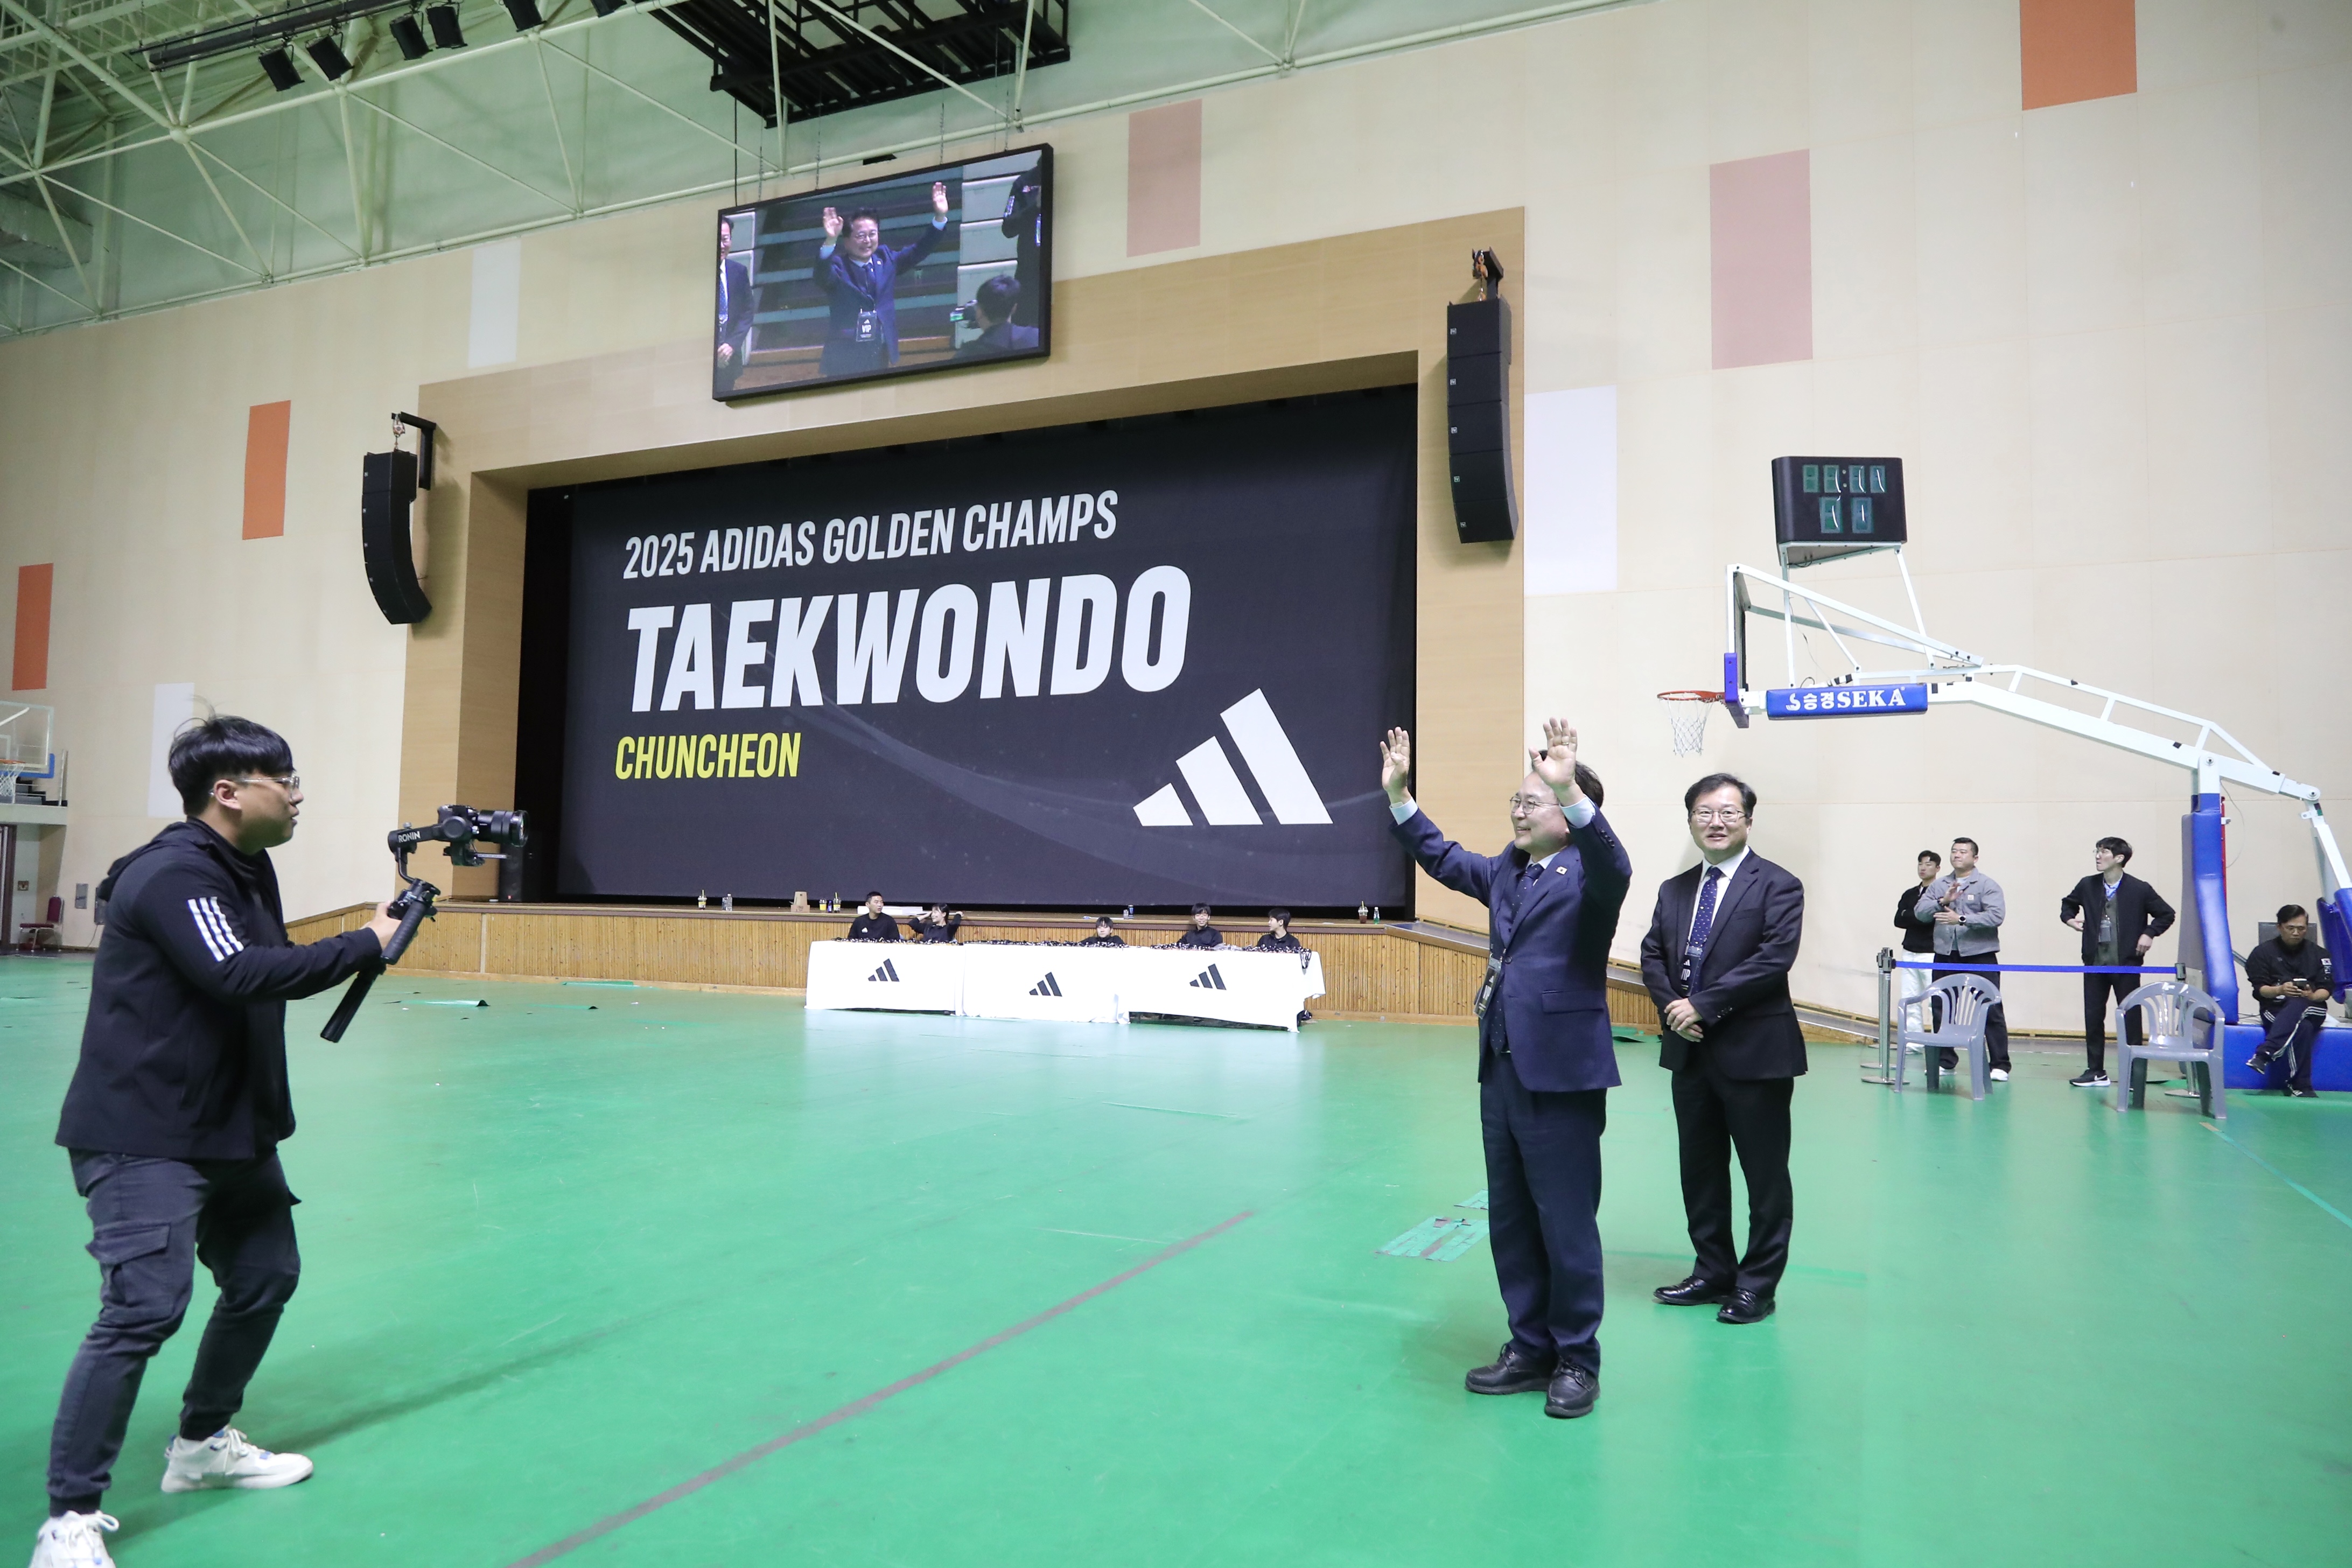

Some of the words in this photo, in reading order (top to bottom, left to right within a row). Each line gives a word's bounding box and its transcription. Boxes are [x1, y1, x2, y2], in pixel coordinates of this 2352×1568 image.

[862, 324, 872, 333] VIP
[623, 532, 695, 579] 2025
[699, 521, 816, 573] ADIDAS
[823, 508, 956, 564] GOLDEN
[963, 490, 1118, 552] CHAMPS
[627, 565, 1191, 712] TAEKWONDO
[1803, 691, 1835, 711] 승경
[1837, 688, 1906, 708] SEKA
[615, 732, 801, 780] CHUNCHEON
[398, 830, 421, 843] RONIN
